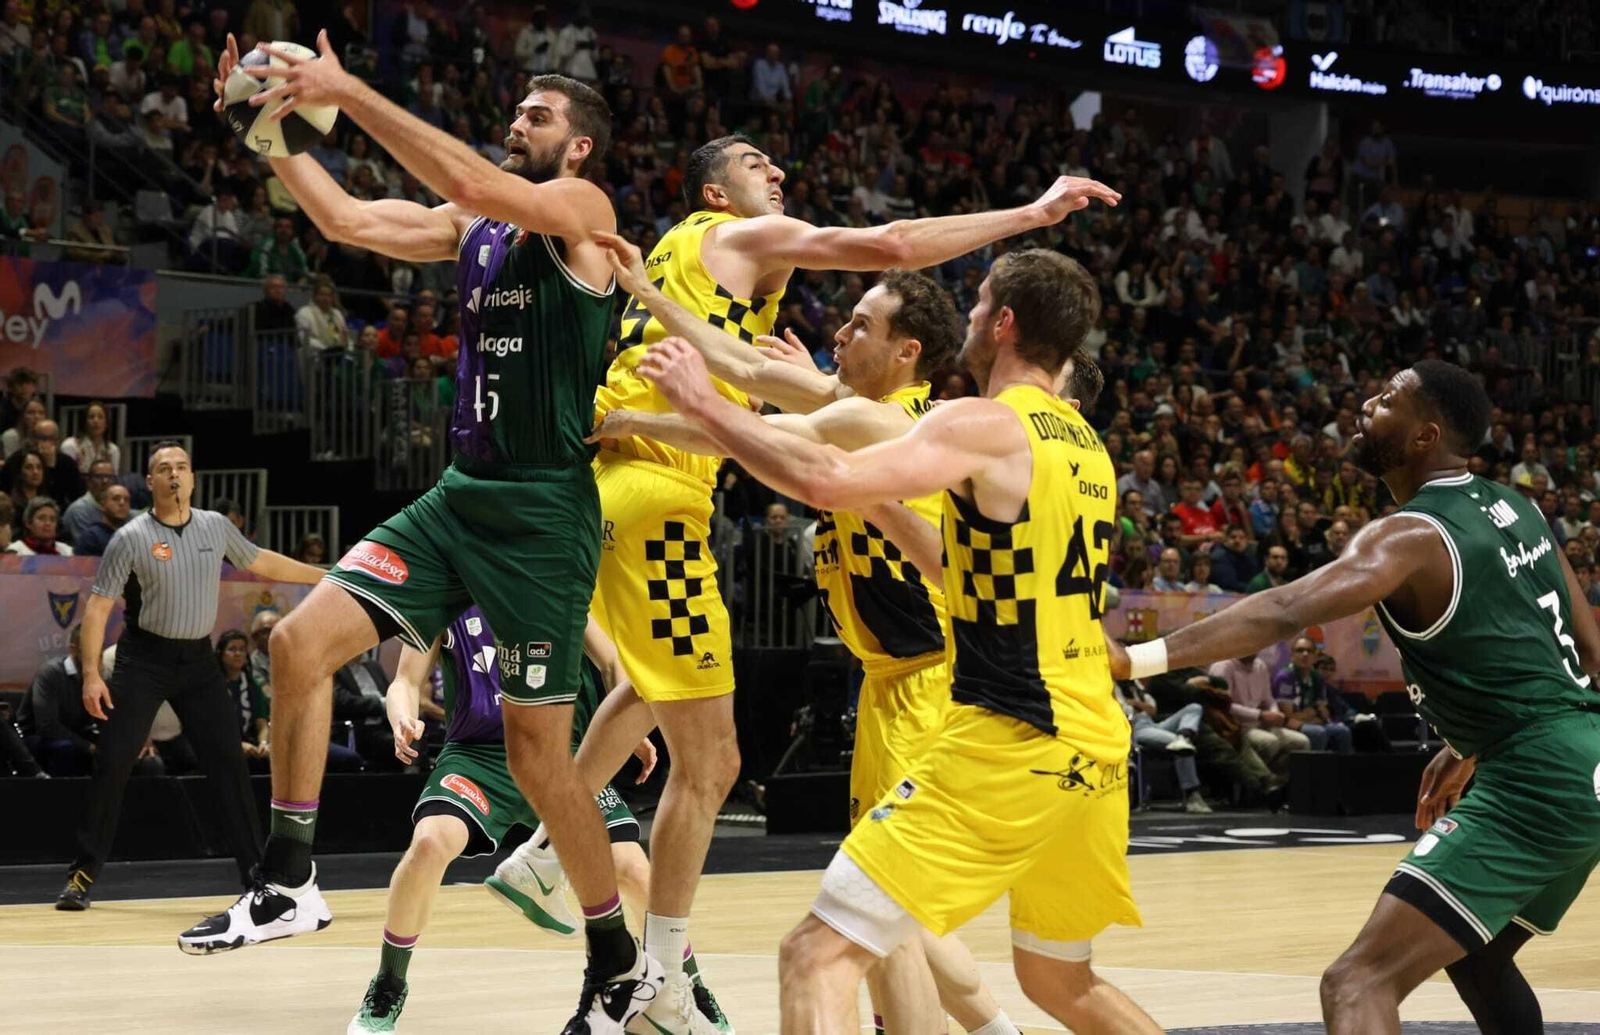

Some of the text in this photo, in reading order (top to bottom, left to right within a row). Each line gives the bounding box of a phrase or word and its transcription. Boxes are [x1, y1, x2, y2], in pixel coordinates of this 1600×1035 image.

[962, 11, 1026, 45] renfe
[1103, 41, 1161, 68] LOTUS
[1055, 515, 1114, 620] 42
[530, 647, 546, 655] acb
